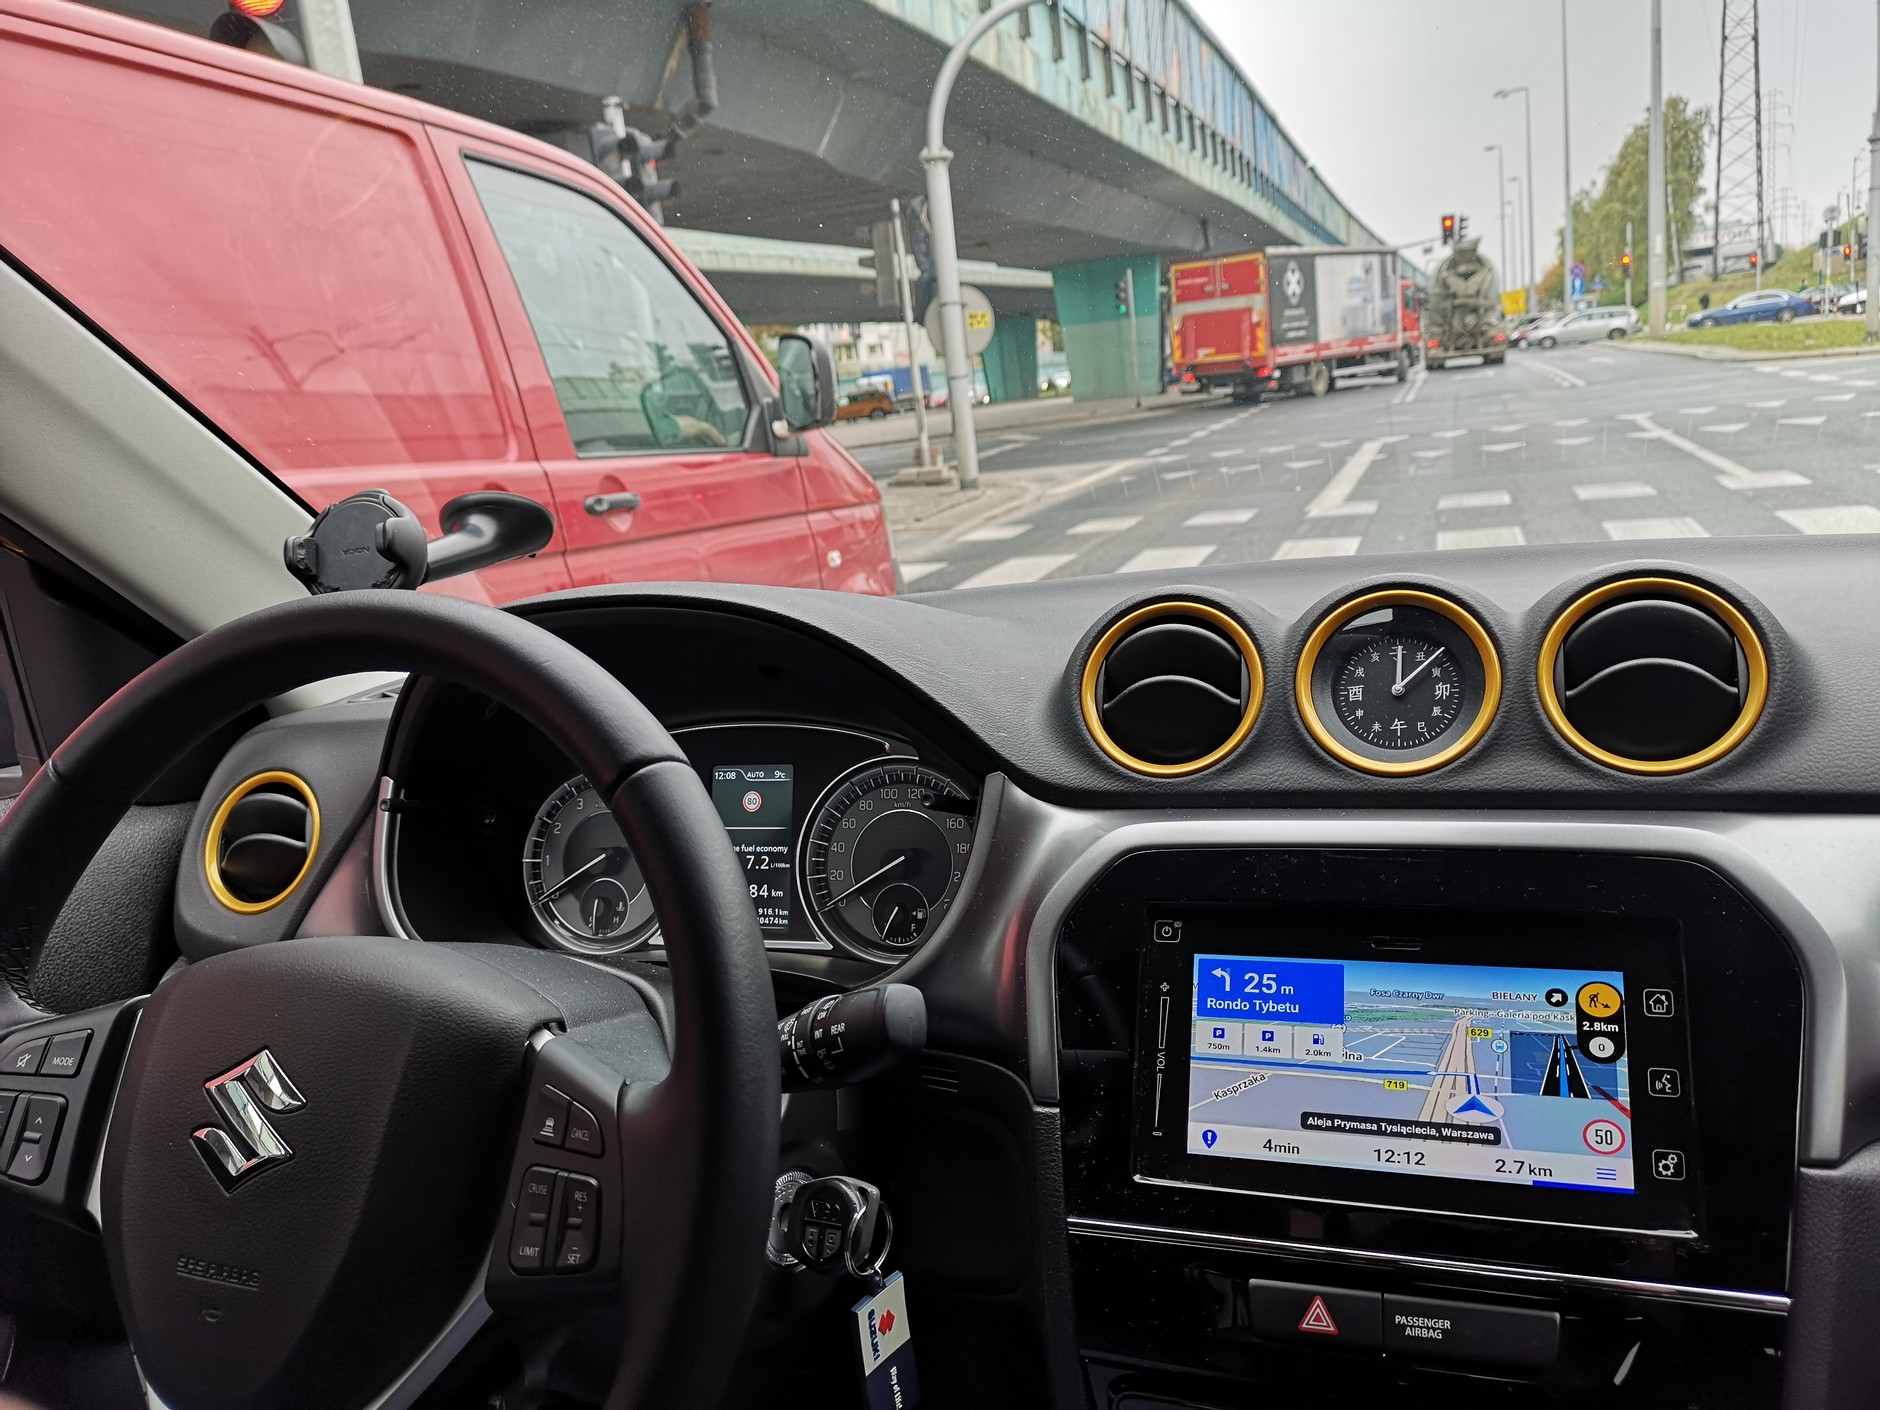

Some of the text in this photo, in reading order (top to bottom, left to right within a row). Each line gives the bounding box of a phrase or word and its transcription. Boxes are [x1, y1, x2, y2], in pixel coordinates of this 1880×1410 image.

[1415, 652, 1426, 661] 丑
[1347, 685, 1364, 701] 酉
[1434, 682, 1450, 700] 卯
[1355, 709, 1364, 719] 申
[1431, 706, 1442, 717] 辰
[1371, 721, 1382, 732] 未
[1390, 718, 1407, 736] 午
[714, 772, 736, 780] 12:08
[880, 788, 898, 799] 100
[576, 799, 584, 810] 3
[747, 798, 757, 806] 80
[859, 800, 873, 810] 80
[554, 822, 561, 834] 2
[842, 818, 856, 829] 60
[946, 818, 964, 829] 160
[741, 844, 755, 852] fuel
[756, 846, 788, 854] economy
[831, 843, 845, 853] 40
[545, 855, 550, 866] 1
[746, 856, 769, 869] 7.2
[830, 870, 844, 880] 20
[749, 884, 783, 898] 84 km
[911, 924, 916, 932] F
[1244, 972, 1294, 995] 25 m
[1370, 989, 1445, 1000] Fosa Czarny Dwr
[1492, 992, 1538, 1001] BIELANY
[1207, 998, 1299, 1014] Rondo Tybetu
[1454, 1008, 1489, 1018] Parking
[1497, 1011, 1530, 1020] Galeria
[1532, 1013, 1551, 1021] pod
[830, 1022, 845, 1035] REAR
[1582, 1021, 1619, 1032] 2.8km
[1470, 1029, 1489, 1037] 629
[1207, 1042, 1230, 1051] 750m
[1255, 1046, 1281, 1054] 1.4km
[1598, 1043, 1605, 1052] 0
[1305, 1049, 1332, 1058] 2.0km
[52, 1056, 74, 1066] MODE
[1156, 1052, 1166, 1072] VOL
[1213, 1072, 1266, 1100] Kasprzaka
[1387, 1081, 1405, 1089] 719
[1307, 1117, 1332, 1128] Aleja
[1334, 1120, 1377, 1131] Prymasa
[1441, 1128, 1494, 1140] Warszawa
[570, 1128, 590, 1141] CANCEL
[1595, 1128, 1613, 1146] 50
[1374, 1149, 1426, 1166] 12:12
[1494, 1158, 1552, 1177] 2.7 km
[528, 1183, 548, 1195] CRUISE
[574, 1191, 587, 1202] RES
[519, 1246, 540, 1257] LIMIT
[567, 1254, 580, 1264] SET
[1395, 1315, 1450, 1329] PASSENGER
[867, 1308, 880, 1362] SUZUKI
[1405, 1326, 1443, 1339] AIRBAG
